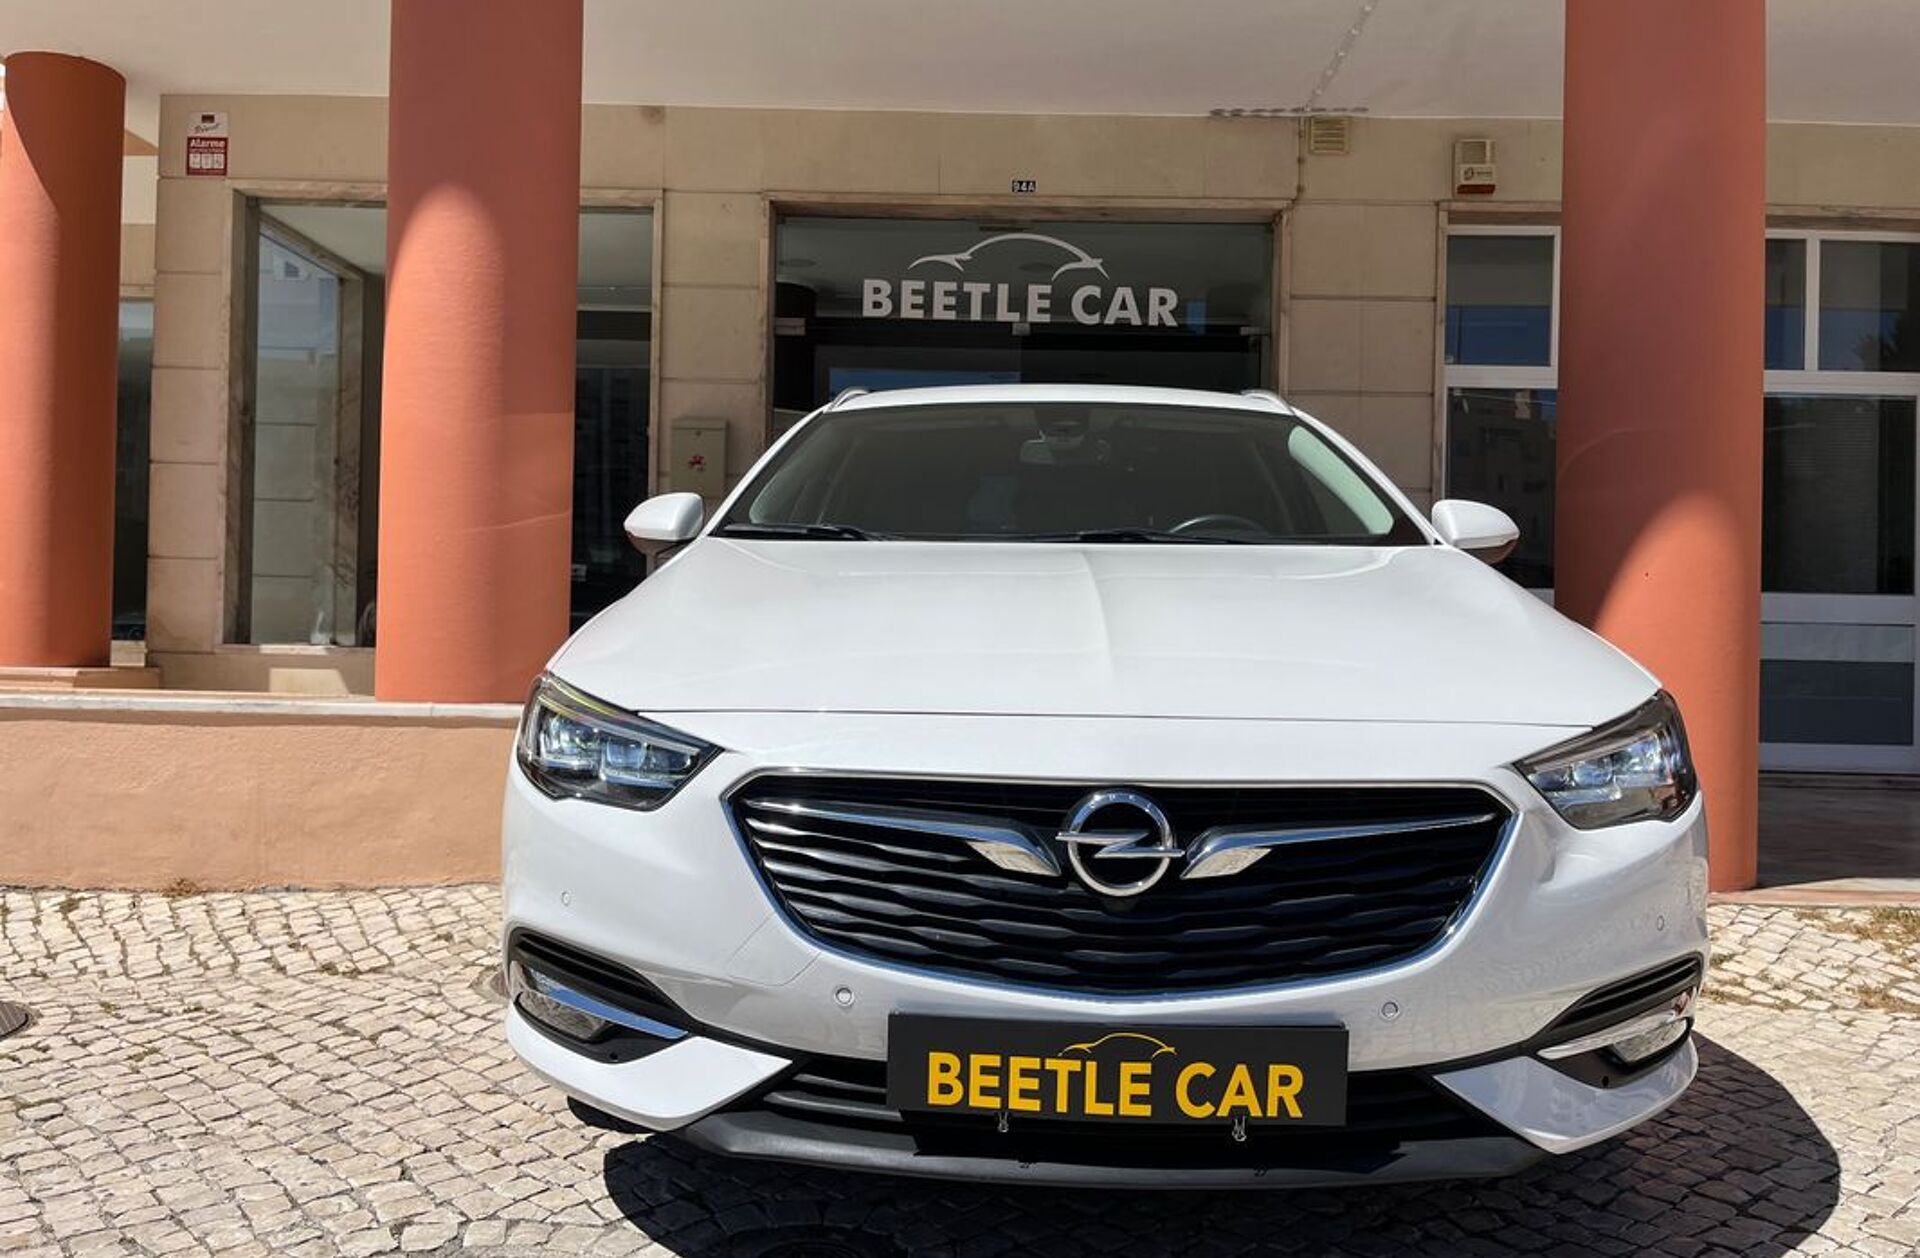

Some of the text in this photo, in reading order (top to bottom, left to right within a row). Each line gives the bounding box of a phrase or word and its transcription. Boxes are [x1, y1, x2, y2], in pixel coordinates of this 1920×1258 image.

[862, 278, 1179, 327] BEETLE CAR
[927, 1051, 1304, 1119] BEETLE CAR
